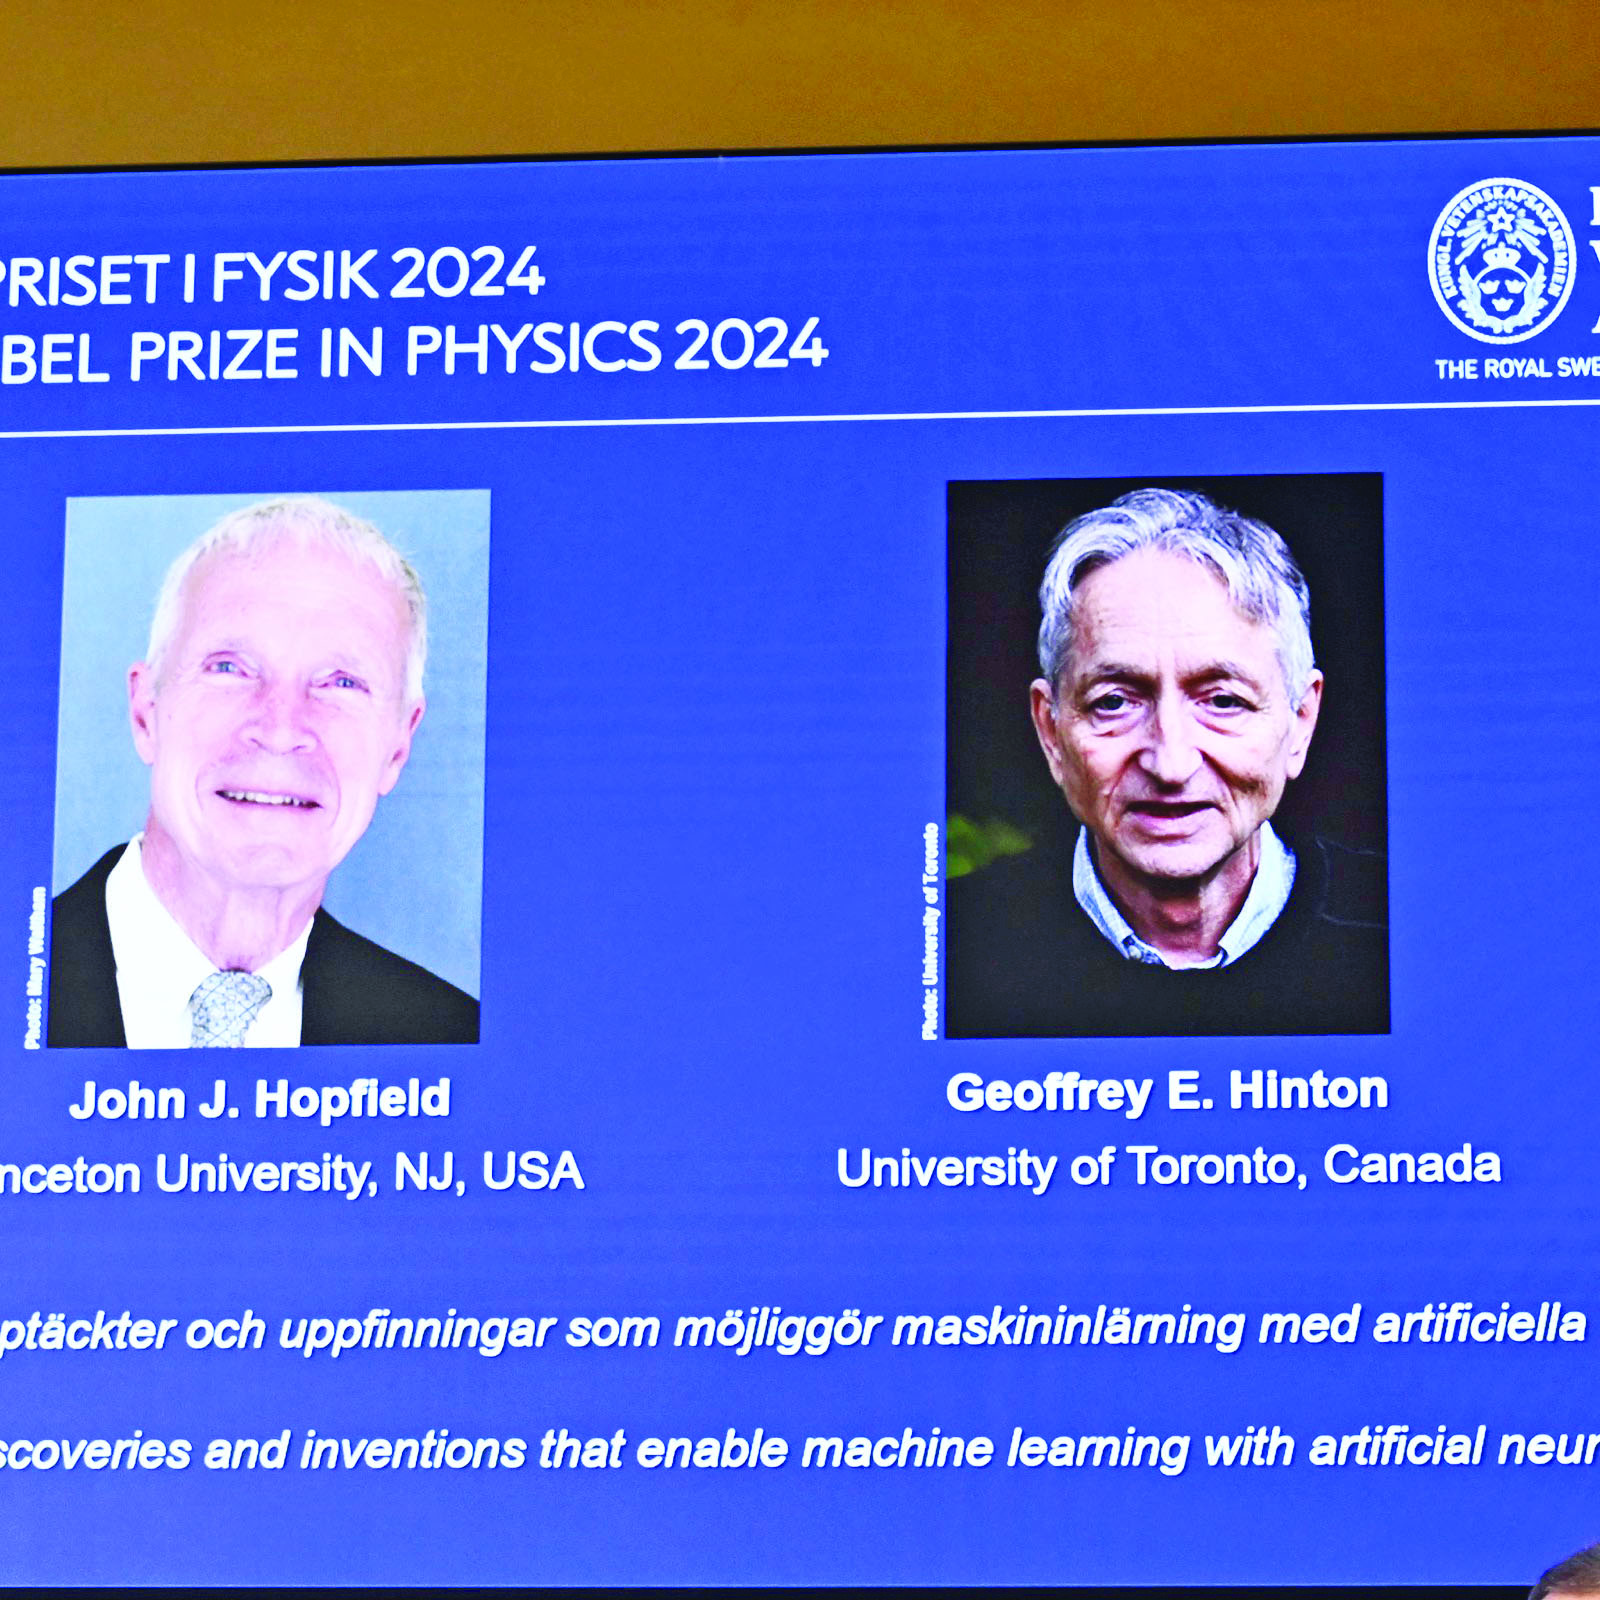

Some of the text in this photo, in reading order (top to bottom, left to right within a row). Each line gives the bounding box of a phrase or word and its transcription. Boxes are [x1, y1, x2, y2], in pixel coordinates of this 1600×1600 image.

[184, 254, 195, 302] I
[214, 250, 379, 302] FYSIK
[391, 246, 545, 297] 2024
[131, 329, 298, 381] PRIZE
[321, 327, 382, 377] IN
[408, 320, 661, 375] PHYSICS
[675, 317, 829, 369] 2024
[1436, 359, 1478, 379] THE
[1485, 358, 1552, 378] ROYAL
[69, 1078, 450, 1126] John J. Hopfield
[947, 1070, 1387, 1119] Geoffrey E. Hinton
[157, 1153, 377, 1200] University,
[396, 1152, 464, 1196] NJ,
[484, 1151, 584, 1189] USA
[838, 1143, 1501, 1195] University of Toronto, Canada
[186, 1310, 265, 1348] och
[280, 1309, 557, 1358] uppfinningar
[566, 1317, 660, 1346] som
[674, 1307, 883, 1355] möjliggör
[892, 1304, 1245, 1352] maskininlärning
[1259, 1303, 1361, 1343] med
[1373, 1302, 1586, 1342] artificiella
[204, 1430, 291, 1469] and
[301, 1429, 527, 1468] inventions
[540, 1429, 626, 1468] that
[637, 1428, 788, 1467] enable
[802, 1428, 993, 1467] machine
[1007, 1427, 1190, 1475] learning
[1205, 1426, 1294, 1465] with
[1309, 1425, 1486, 1465] artificial
